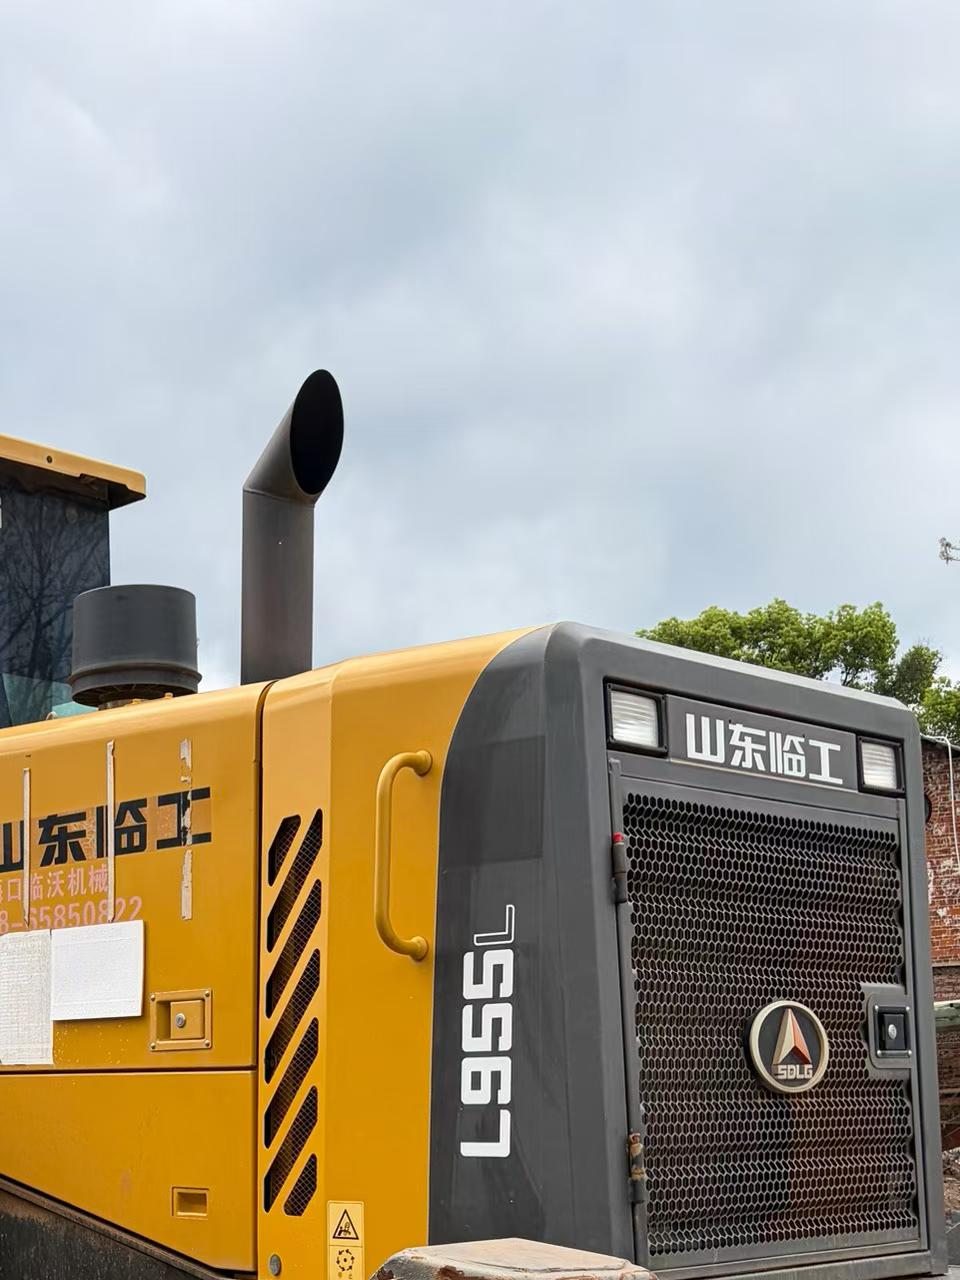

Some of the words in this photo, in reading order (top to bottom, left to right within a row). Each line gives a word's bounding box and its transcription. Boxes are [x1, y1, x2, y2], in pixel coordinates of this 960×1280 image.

[685, 713, 842, 784] 山东临工
[777, 1064, 813, 1080] SDLG
